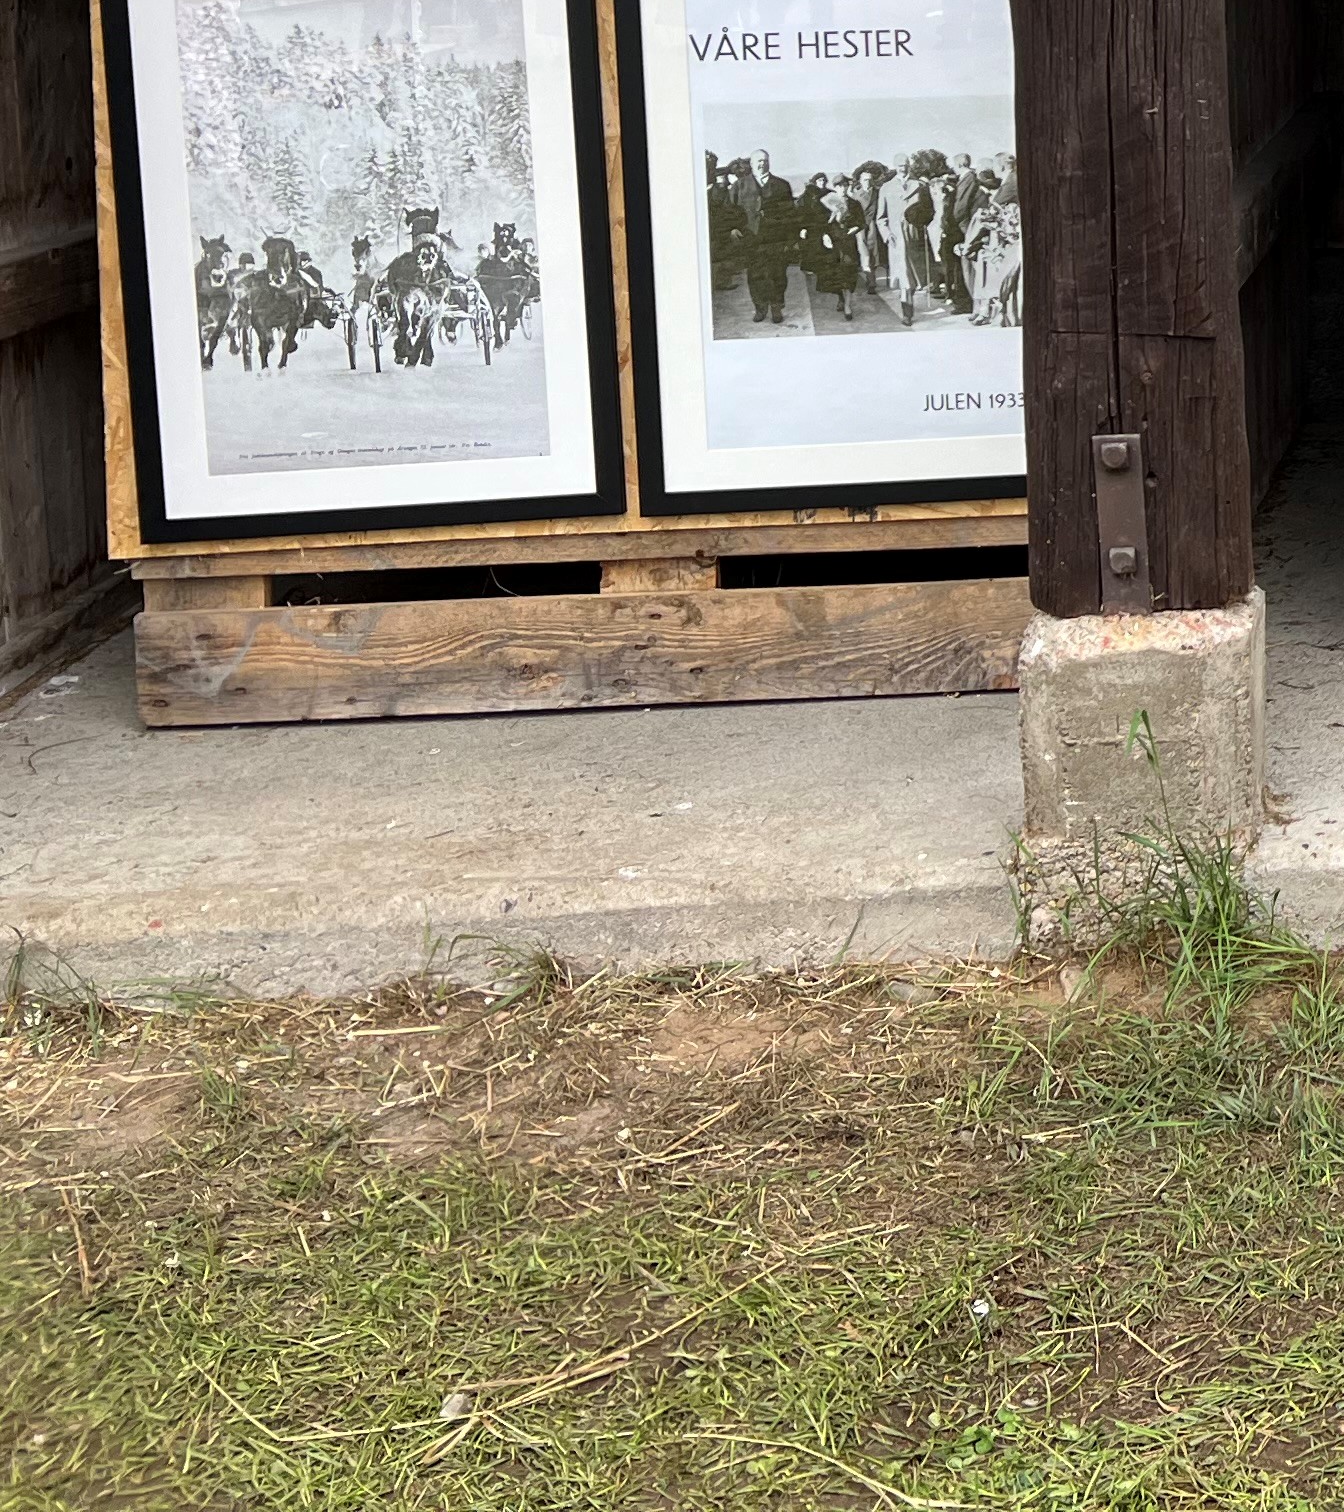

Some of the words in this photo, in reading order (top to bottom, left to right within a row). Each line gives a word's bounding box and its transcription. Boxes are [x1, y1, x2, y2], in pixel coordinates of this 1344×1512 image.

[689, 26, 781, 61] VÅRE
[798, 29, 914, 59] HESTER
[923, 392, 981, 412] JULEN
